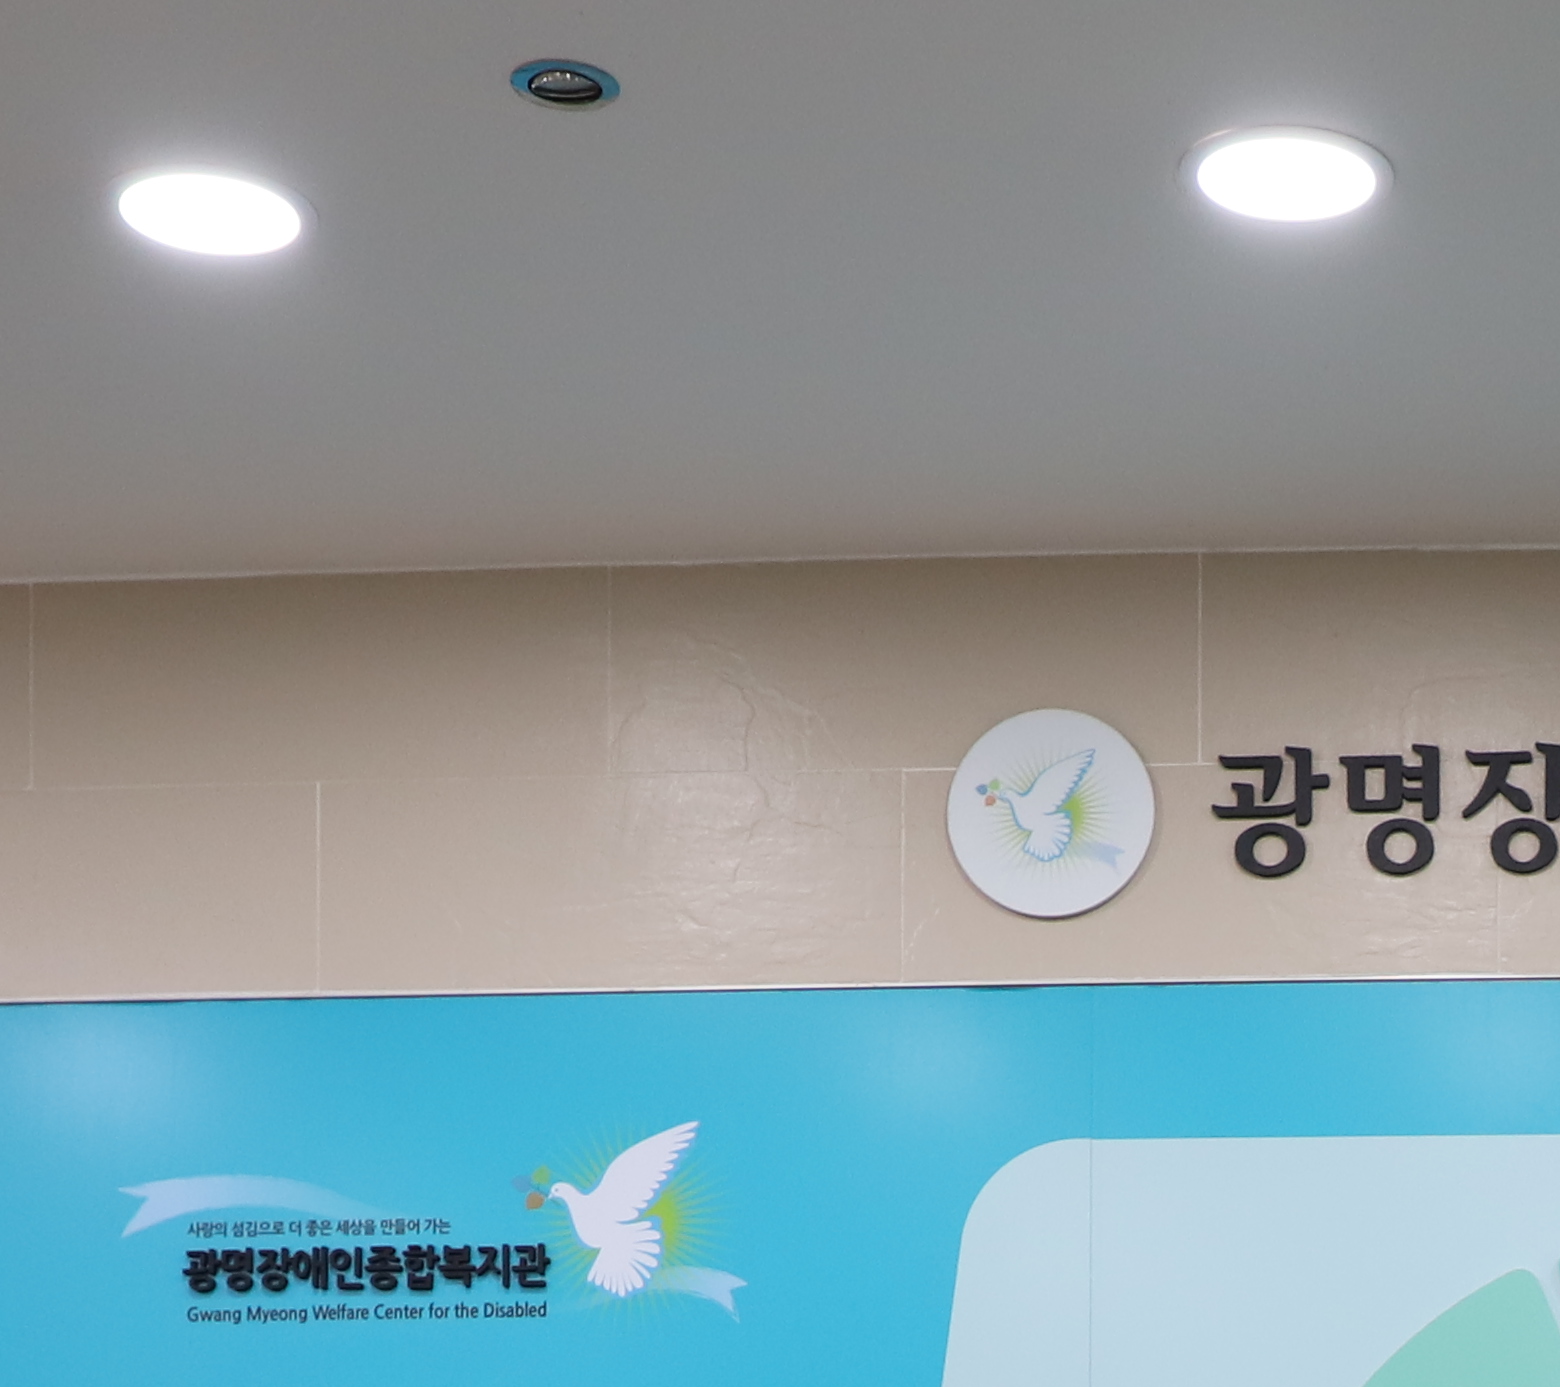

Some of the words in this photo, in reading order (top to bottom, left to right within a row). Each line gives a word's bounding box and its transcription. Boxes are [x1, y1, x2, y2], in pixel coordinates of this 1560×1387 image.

[181, 1243, 550, 1291] 광명장애인종합복지관
[187, 1307, 241, 1324] Gwang
[247, 1306, 308, 1323] Myeong
[312, 1304, 369, 1320] Welfare
[374, 1304, 424, 1319] Center
[429, 1303, 449, 1319] for
[454, 1302, 479, 1318] the
[484, 1301, 547, 1318] Disabled
